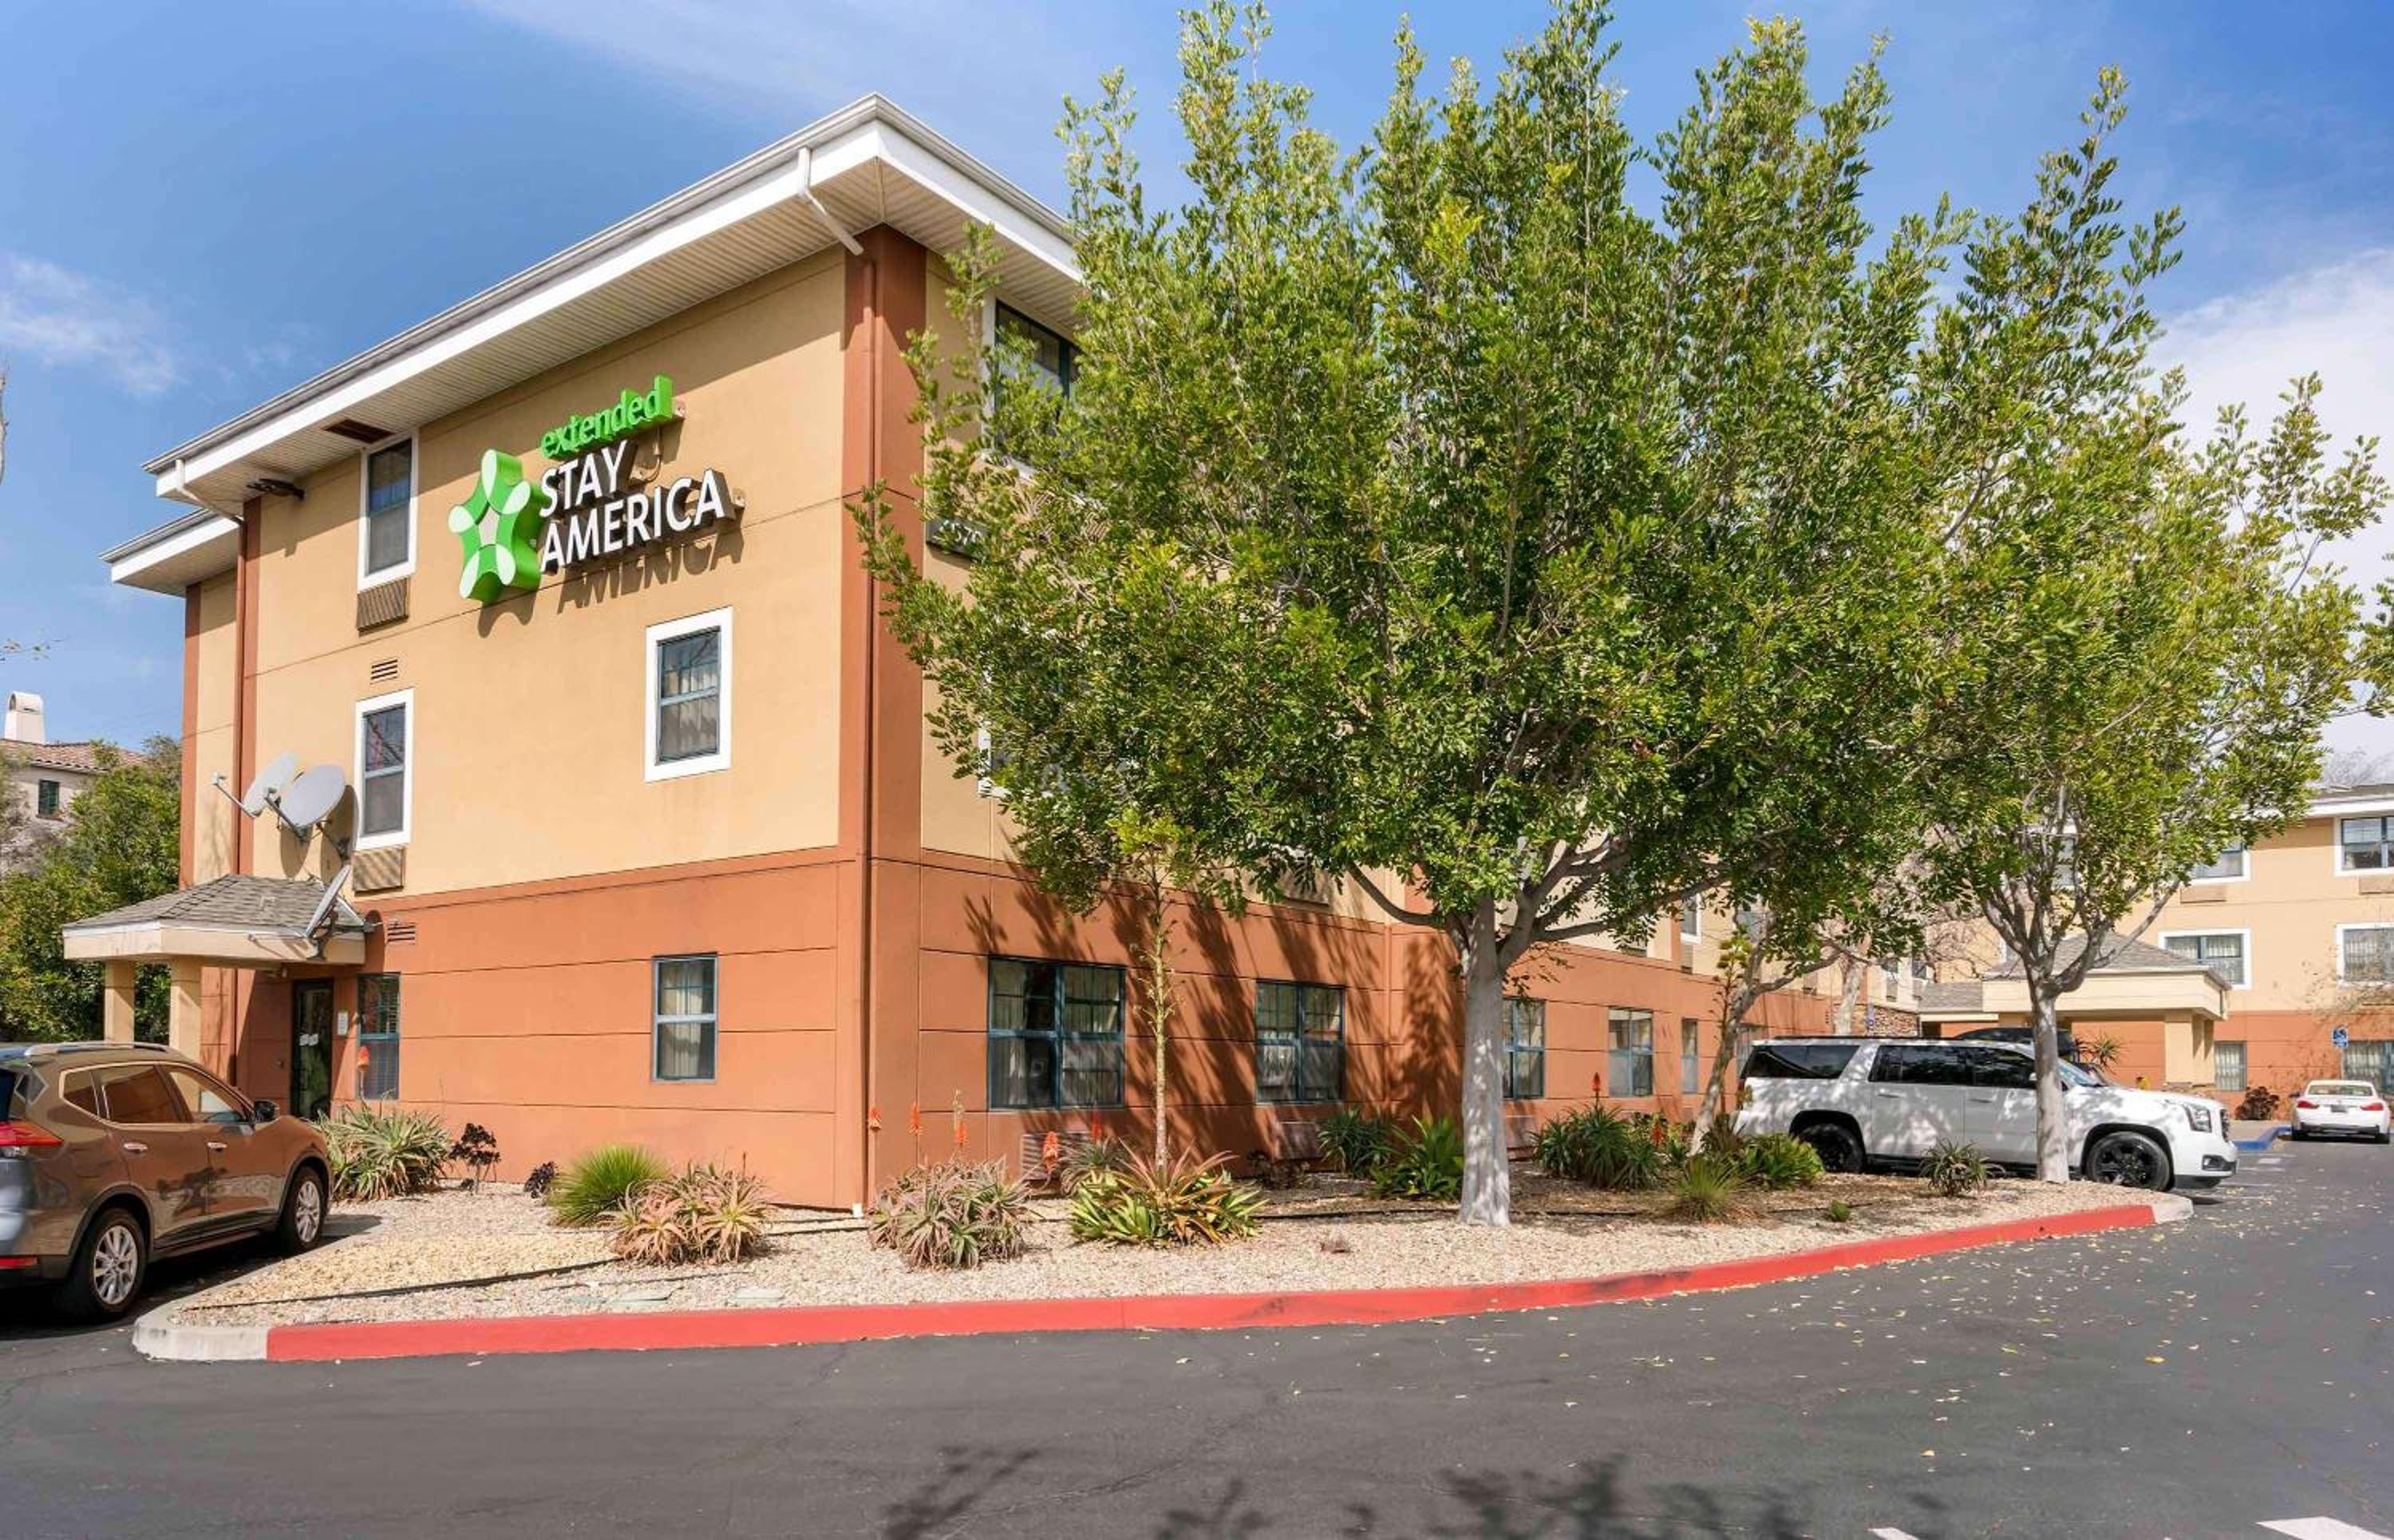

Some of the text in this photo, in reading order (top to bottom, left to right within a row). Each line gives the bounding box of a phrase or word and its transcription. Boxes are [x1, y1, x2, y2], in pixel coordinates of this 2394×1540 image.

[540, 375, 673, 458] extended
[539, 440, 628, 518] STAY
[539, 468, 726, 574] AMERICA
